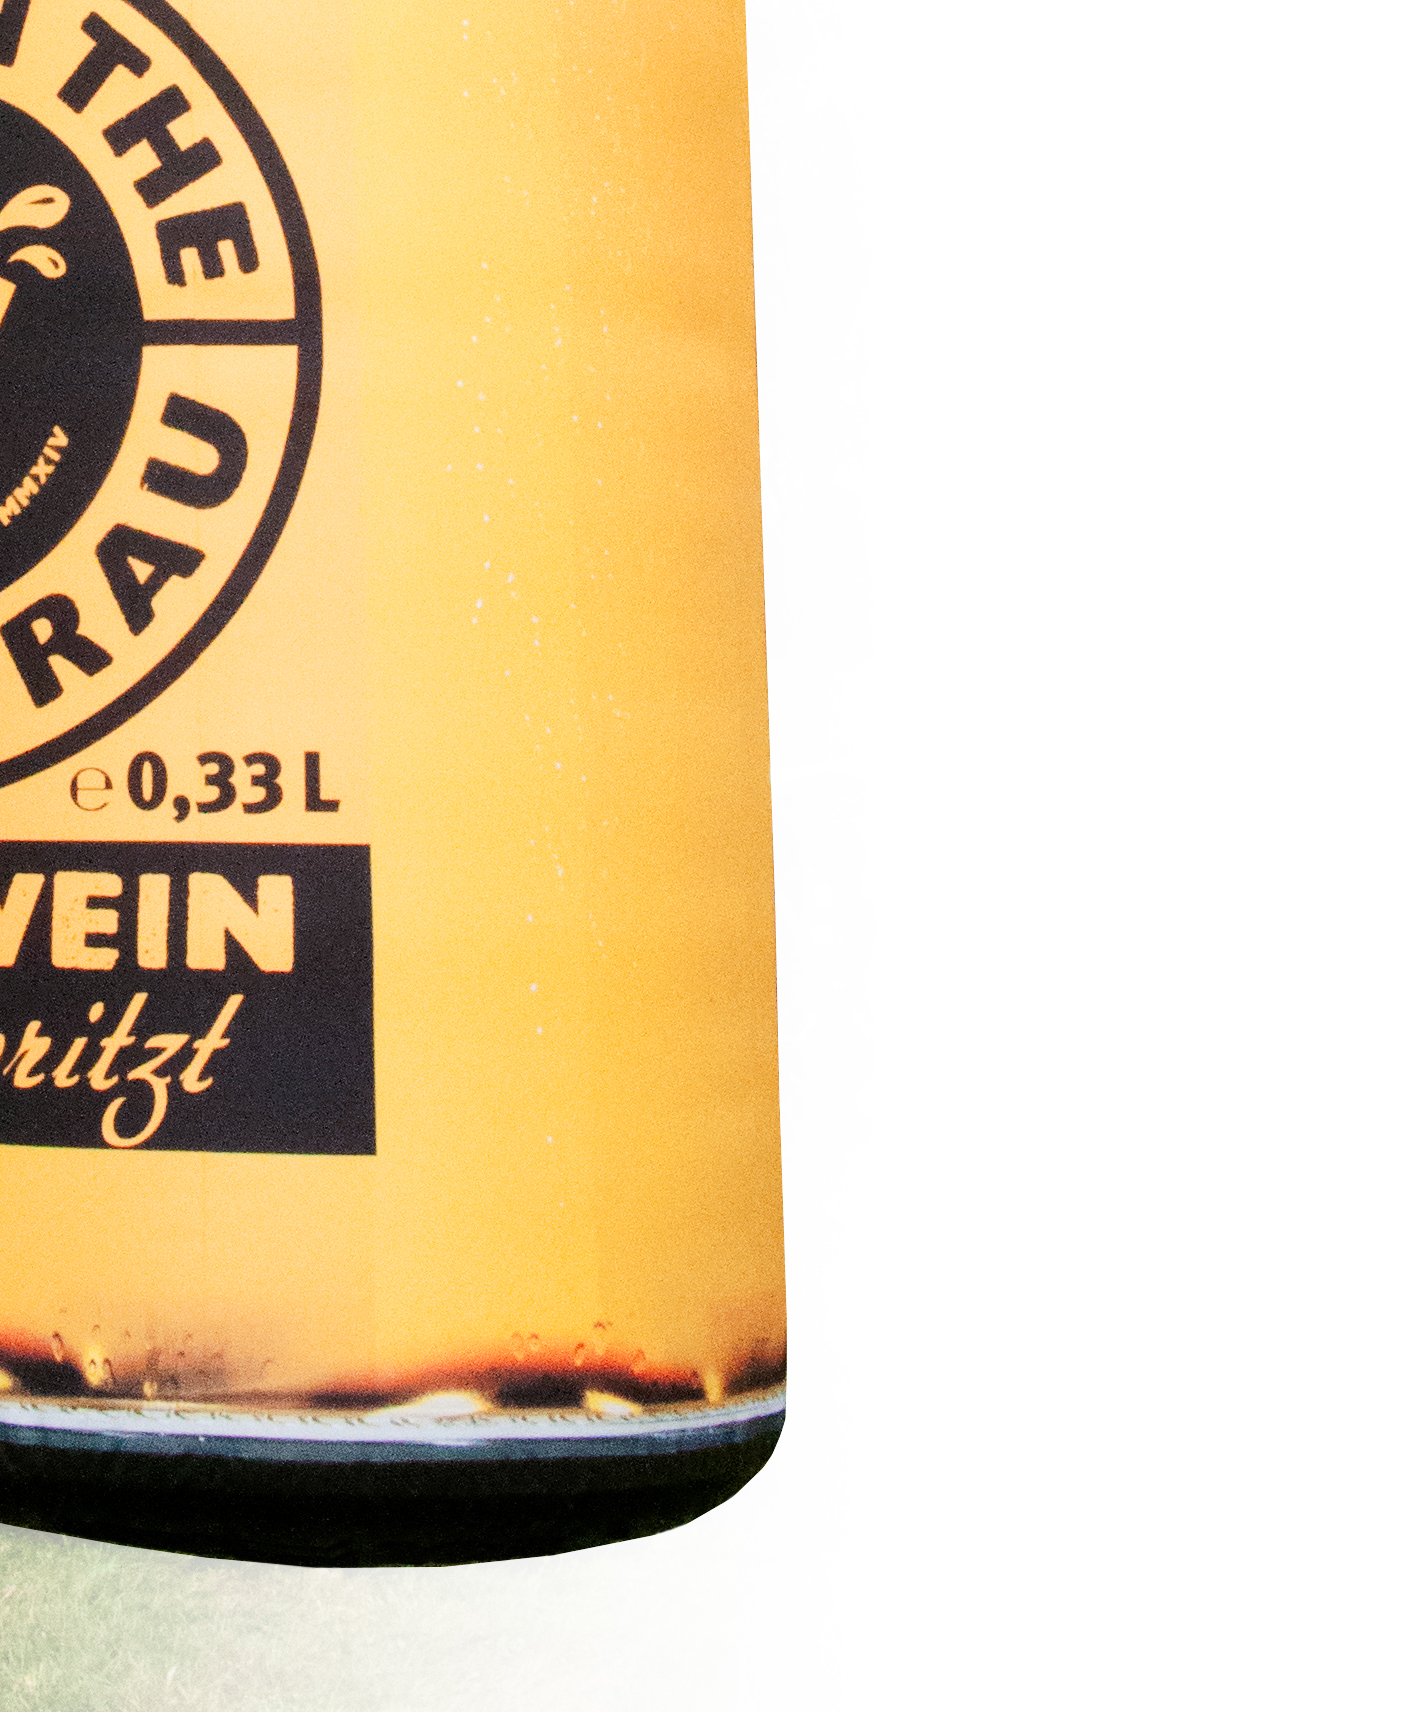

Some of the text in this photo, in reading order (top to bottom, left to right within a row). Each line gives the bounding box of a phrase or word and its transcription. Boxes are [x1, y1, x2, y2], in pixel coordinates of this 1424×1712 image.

[57, 11, 260, 287] THE
[128, 750, 283, 822] 0,33
[305, 751, 340, 813] L
